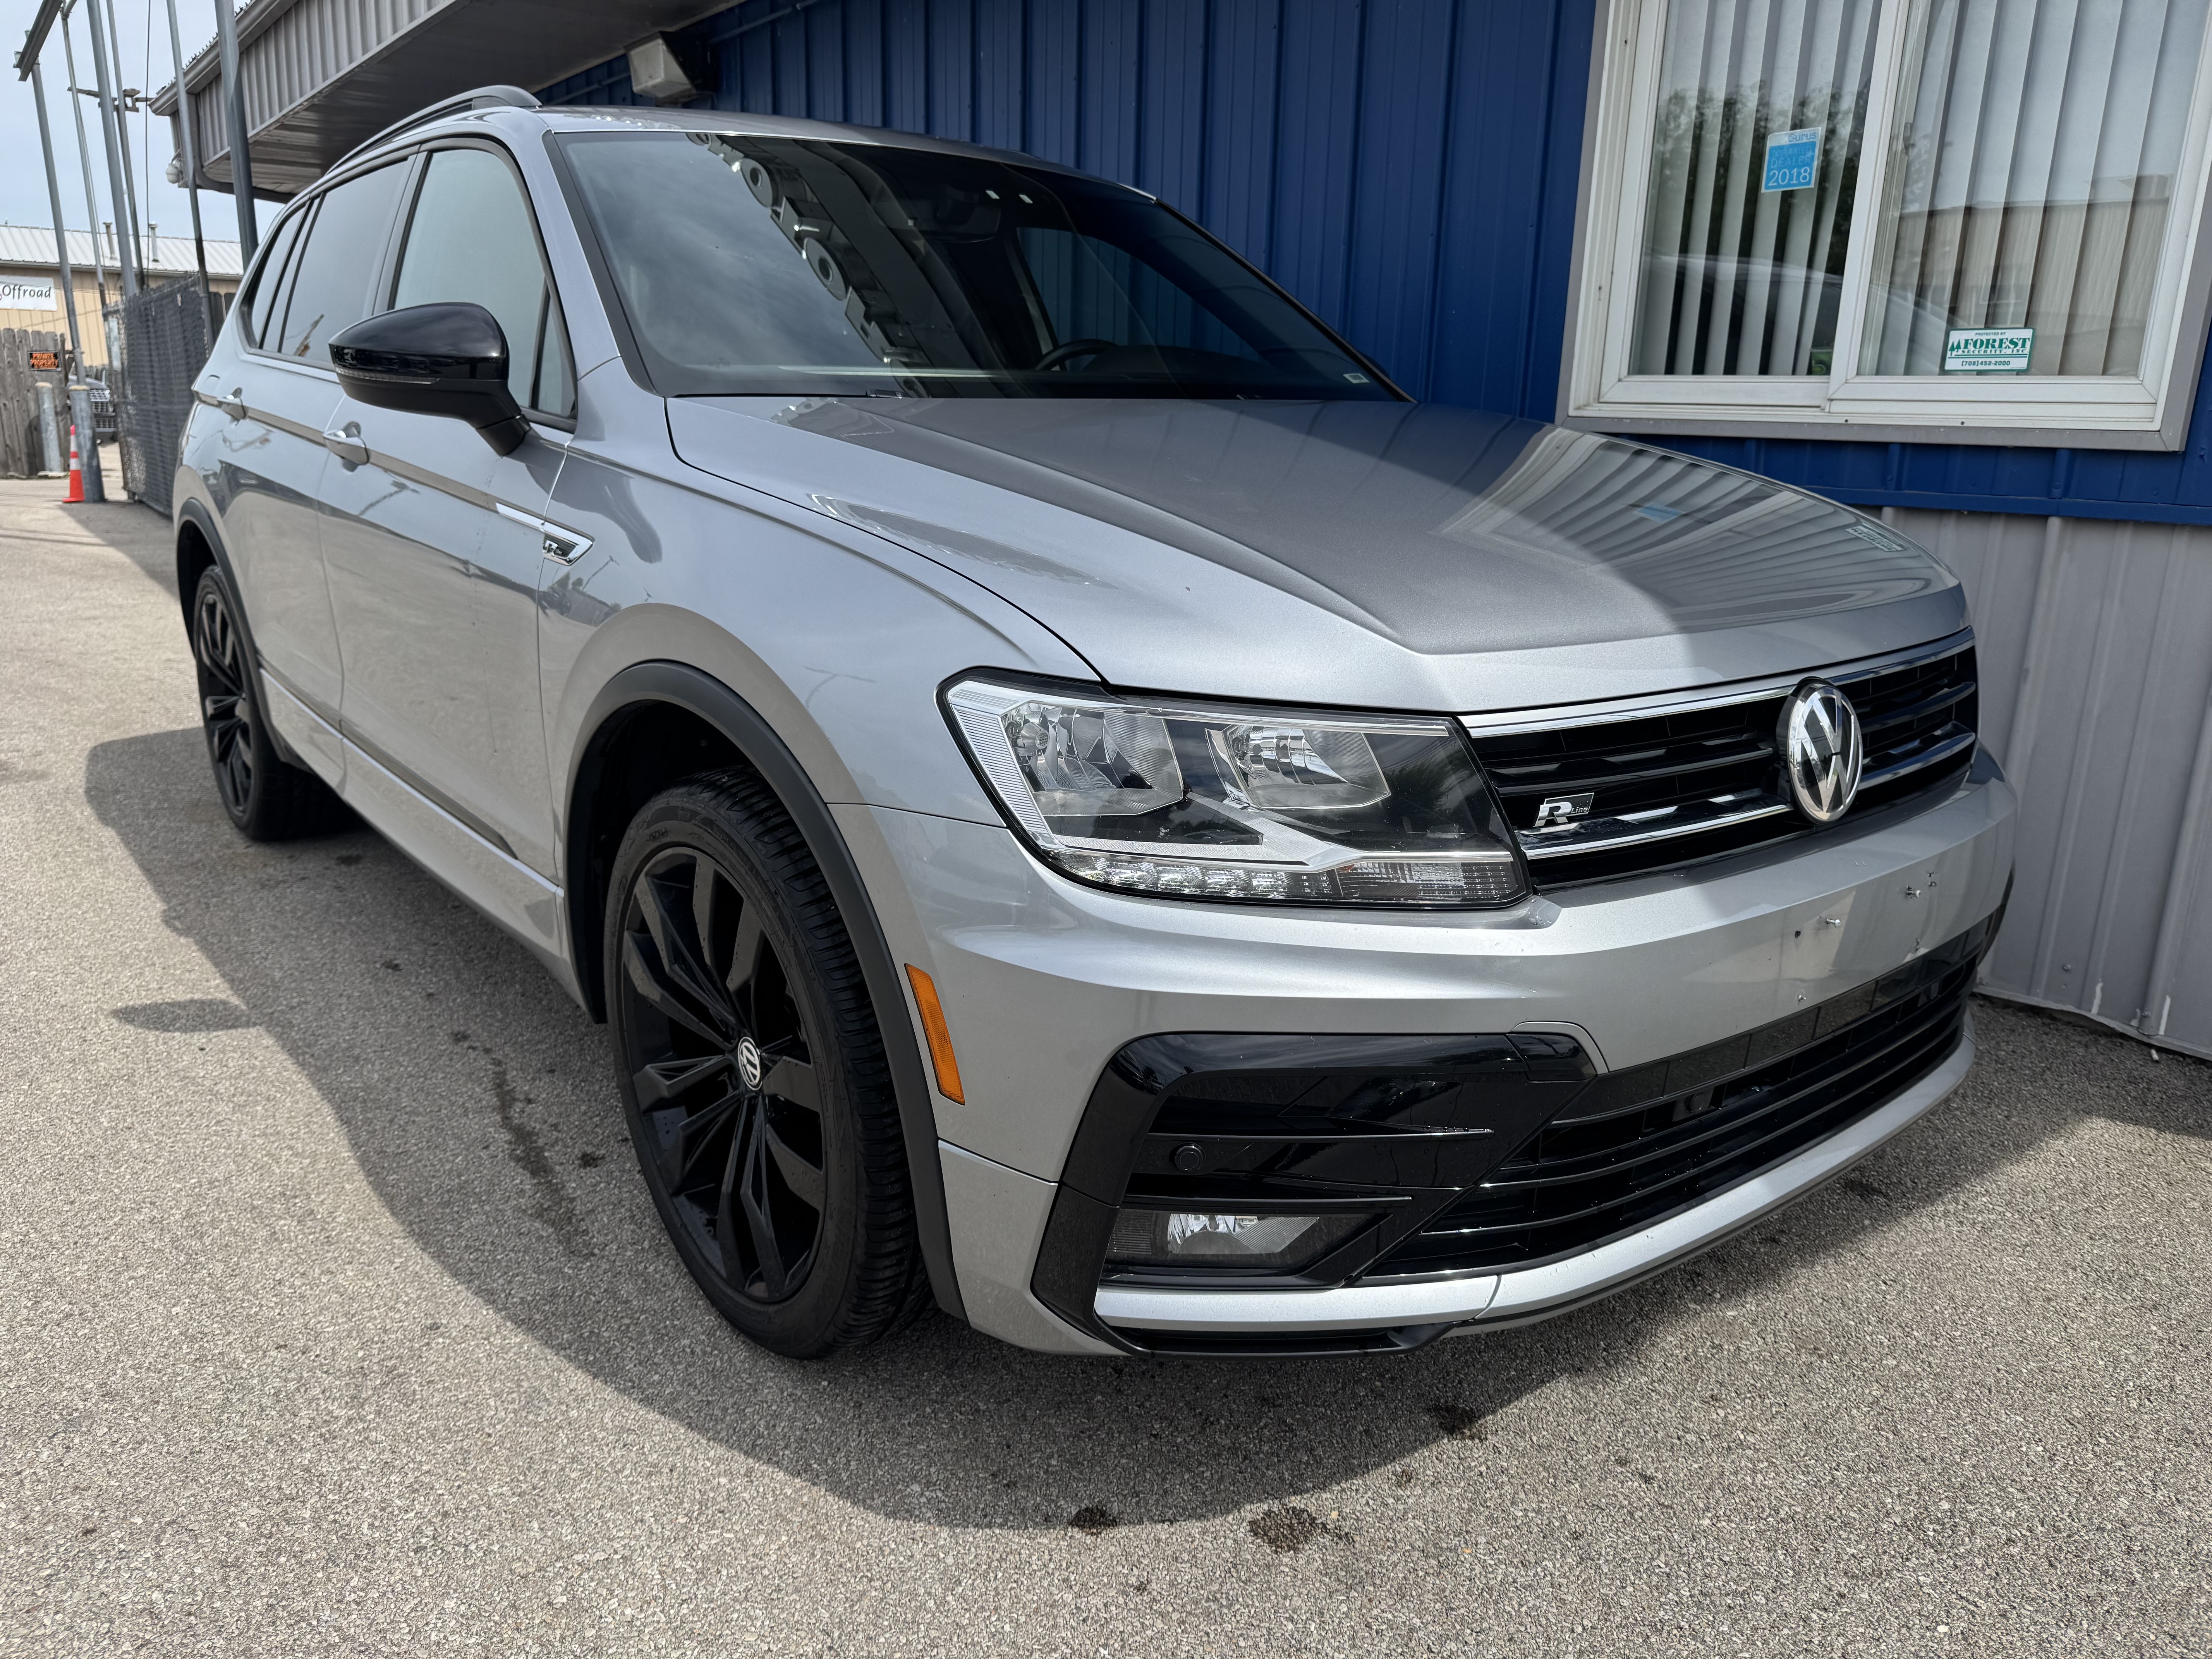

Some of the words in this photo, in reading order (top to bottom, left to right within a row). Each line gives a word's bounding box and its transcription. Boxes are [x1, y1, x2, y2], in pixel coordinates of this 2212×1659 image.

[1788, 132, 1816, 142] Gurus
[1771, 155, 1811, 168] DEALER
[1768, 167, 1810, 186] 2018
[2, 284, 51, 300] Offroad
[1963, 337, 2030, 349] FOREST
